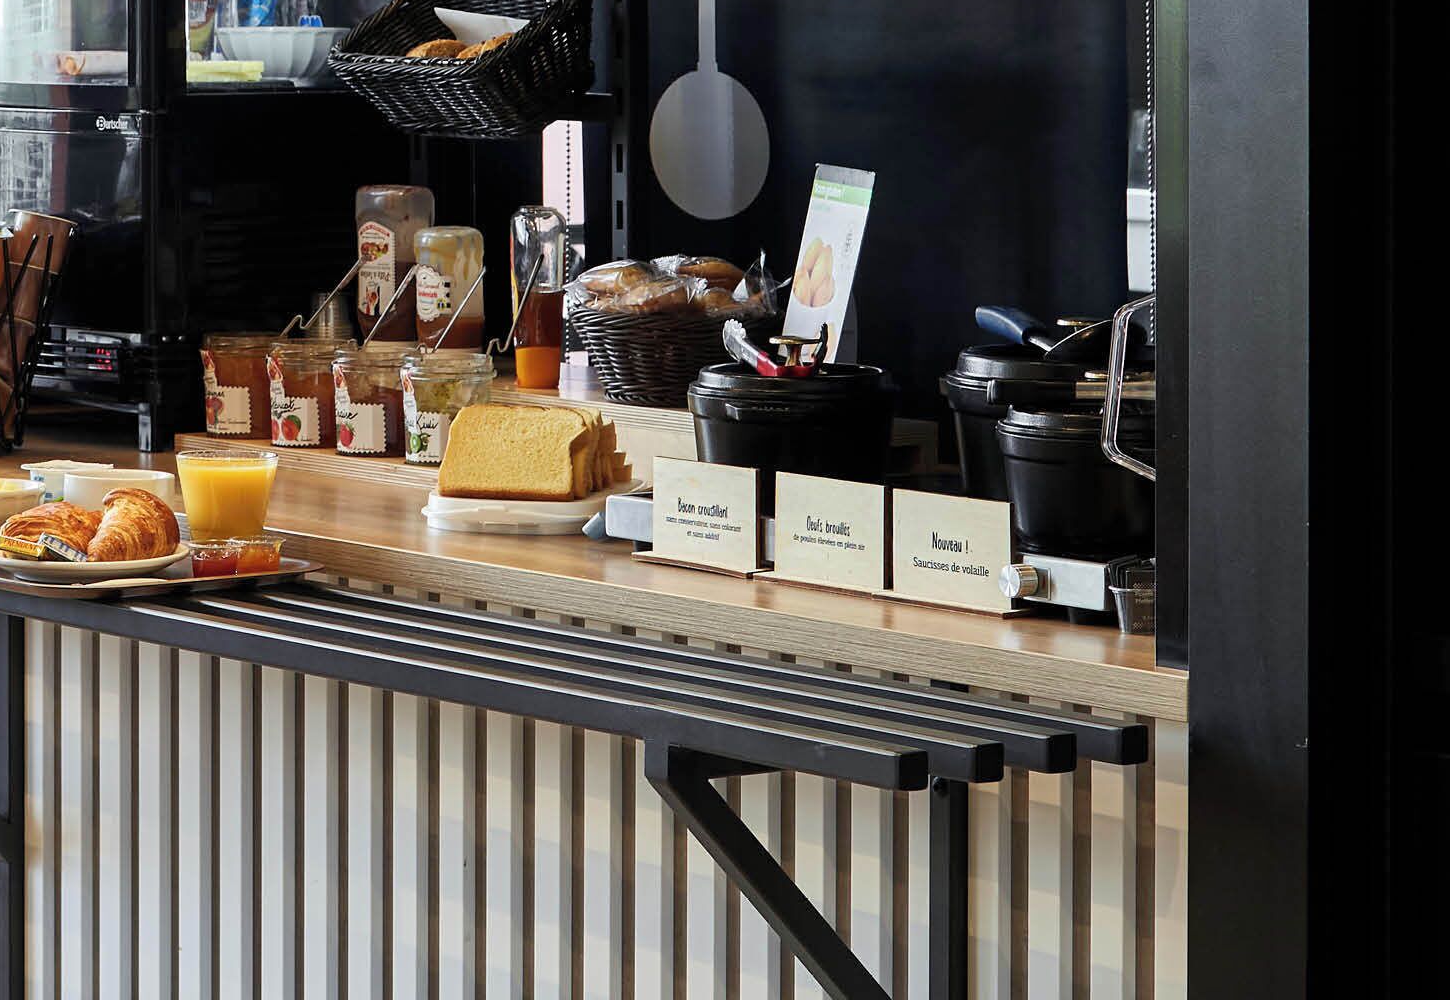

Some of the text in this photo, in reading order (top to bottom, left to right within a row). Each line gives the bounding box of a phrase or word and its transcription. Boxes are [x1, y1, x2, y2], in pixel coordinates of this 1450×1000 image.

[677, 497, 696, 513] Bacon
[806, 515, 823, 533] Oeufs
[932, 531, 963, 553] Nouveau
[913, 556, 990, 577] Saucisses de volaille
